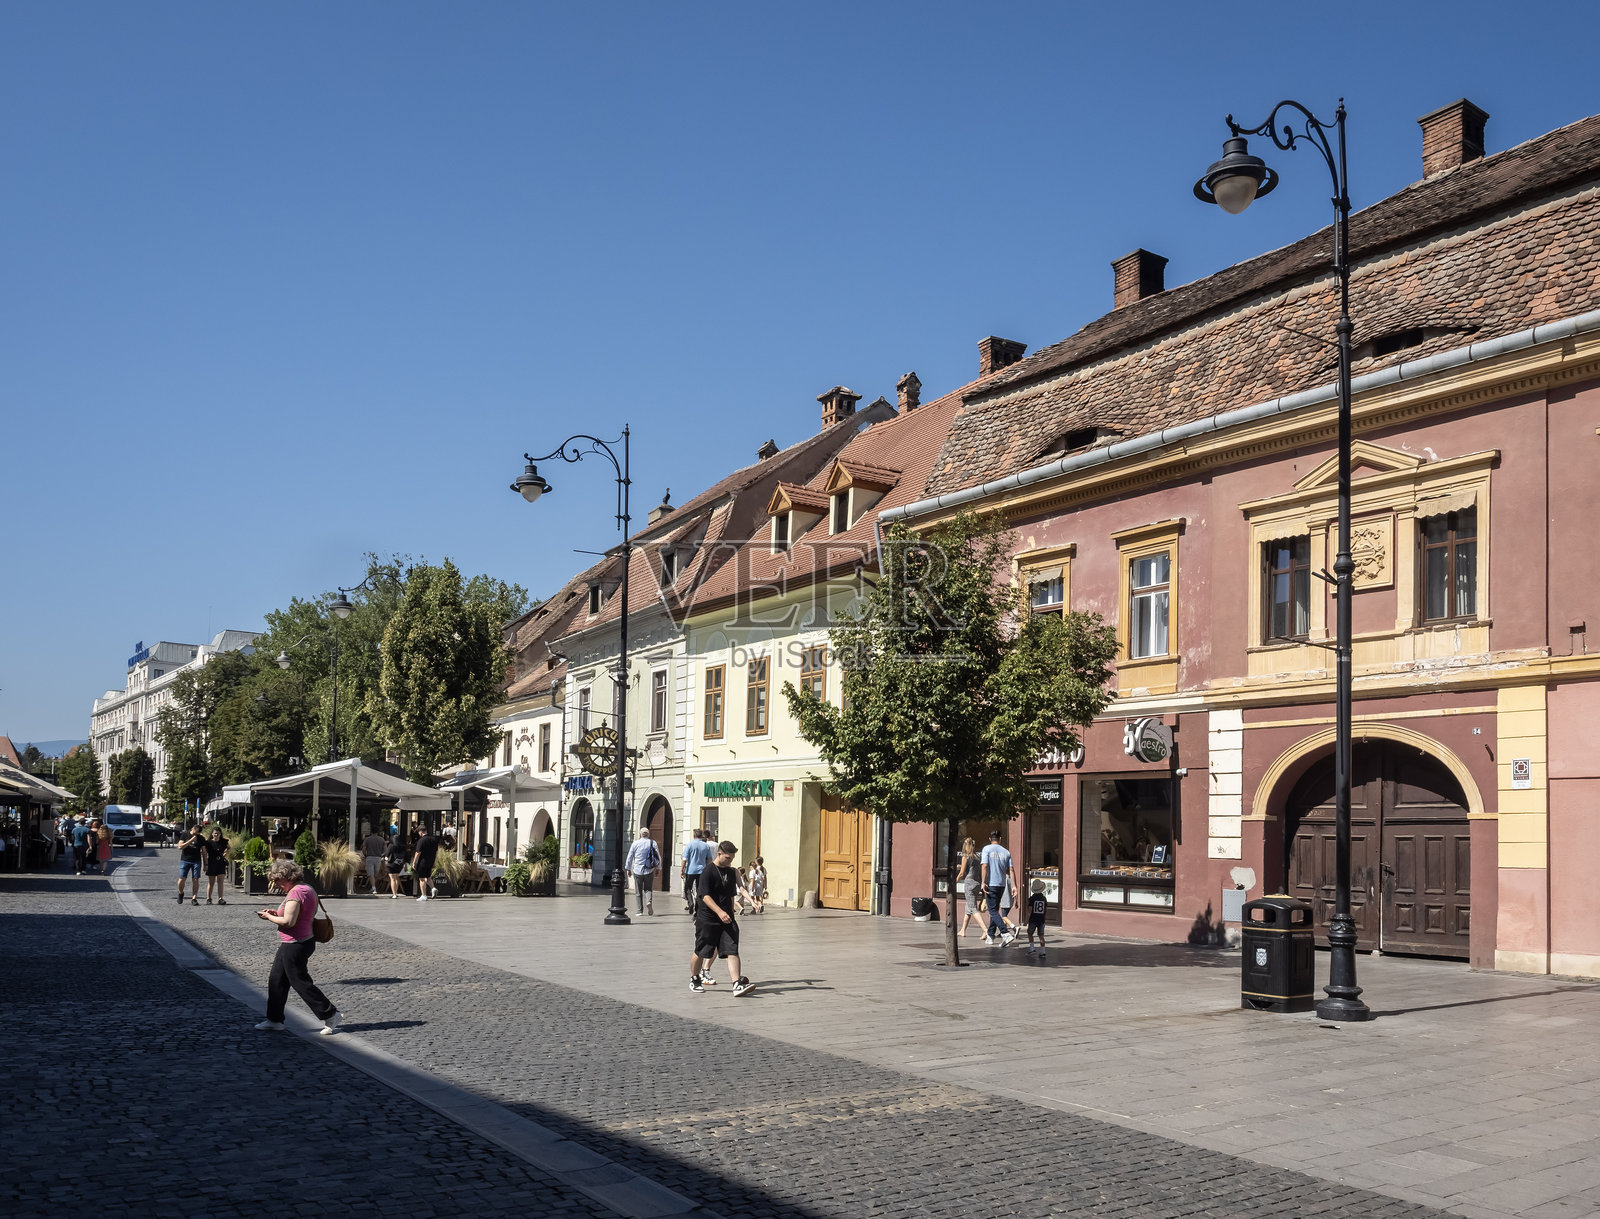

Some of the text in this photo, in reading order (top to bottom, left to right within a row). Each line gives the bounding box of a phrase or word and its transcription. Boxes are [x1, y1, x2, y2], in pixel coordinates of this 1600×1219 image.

[584, 728, 619, 744] UNICU
[584, 756, 619, 774] TREFFPUN
[1034, 901, 1045, 912] 18
